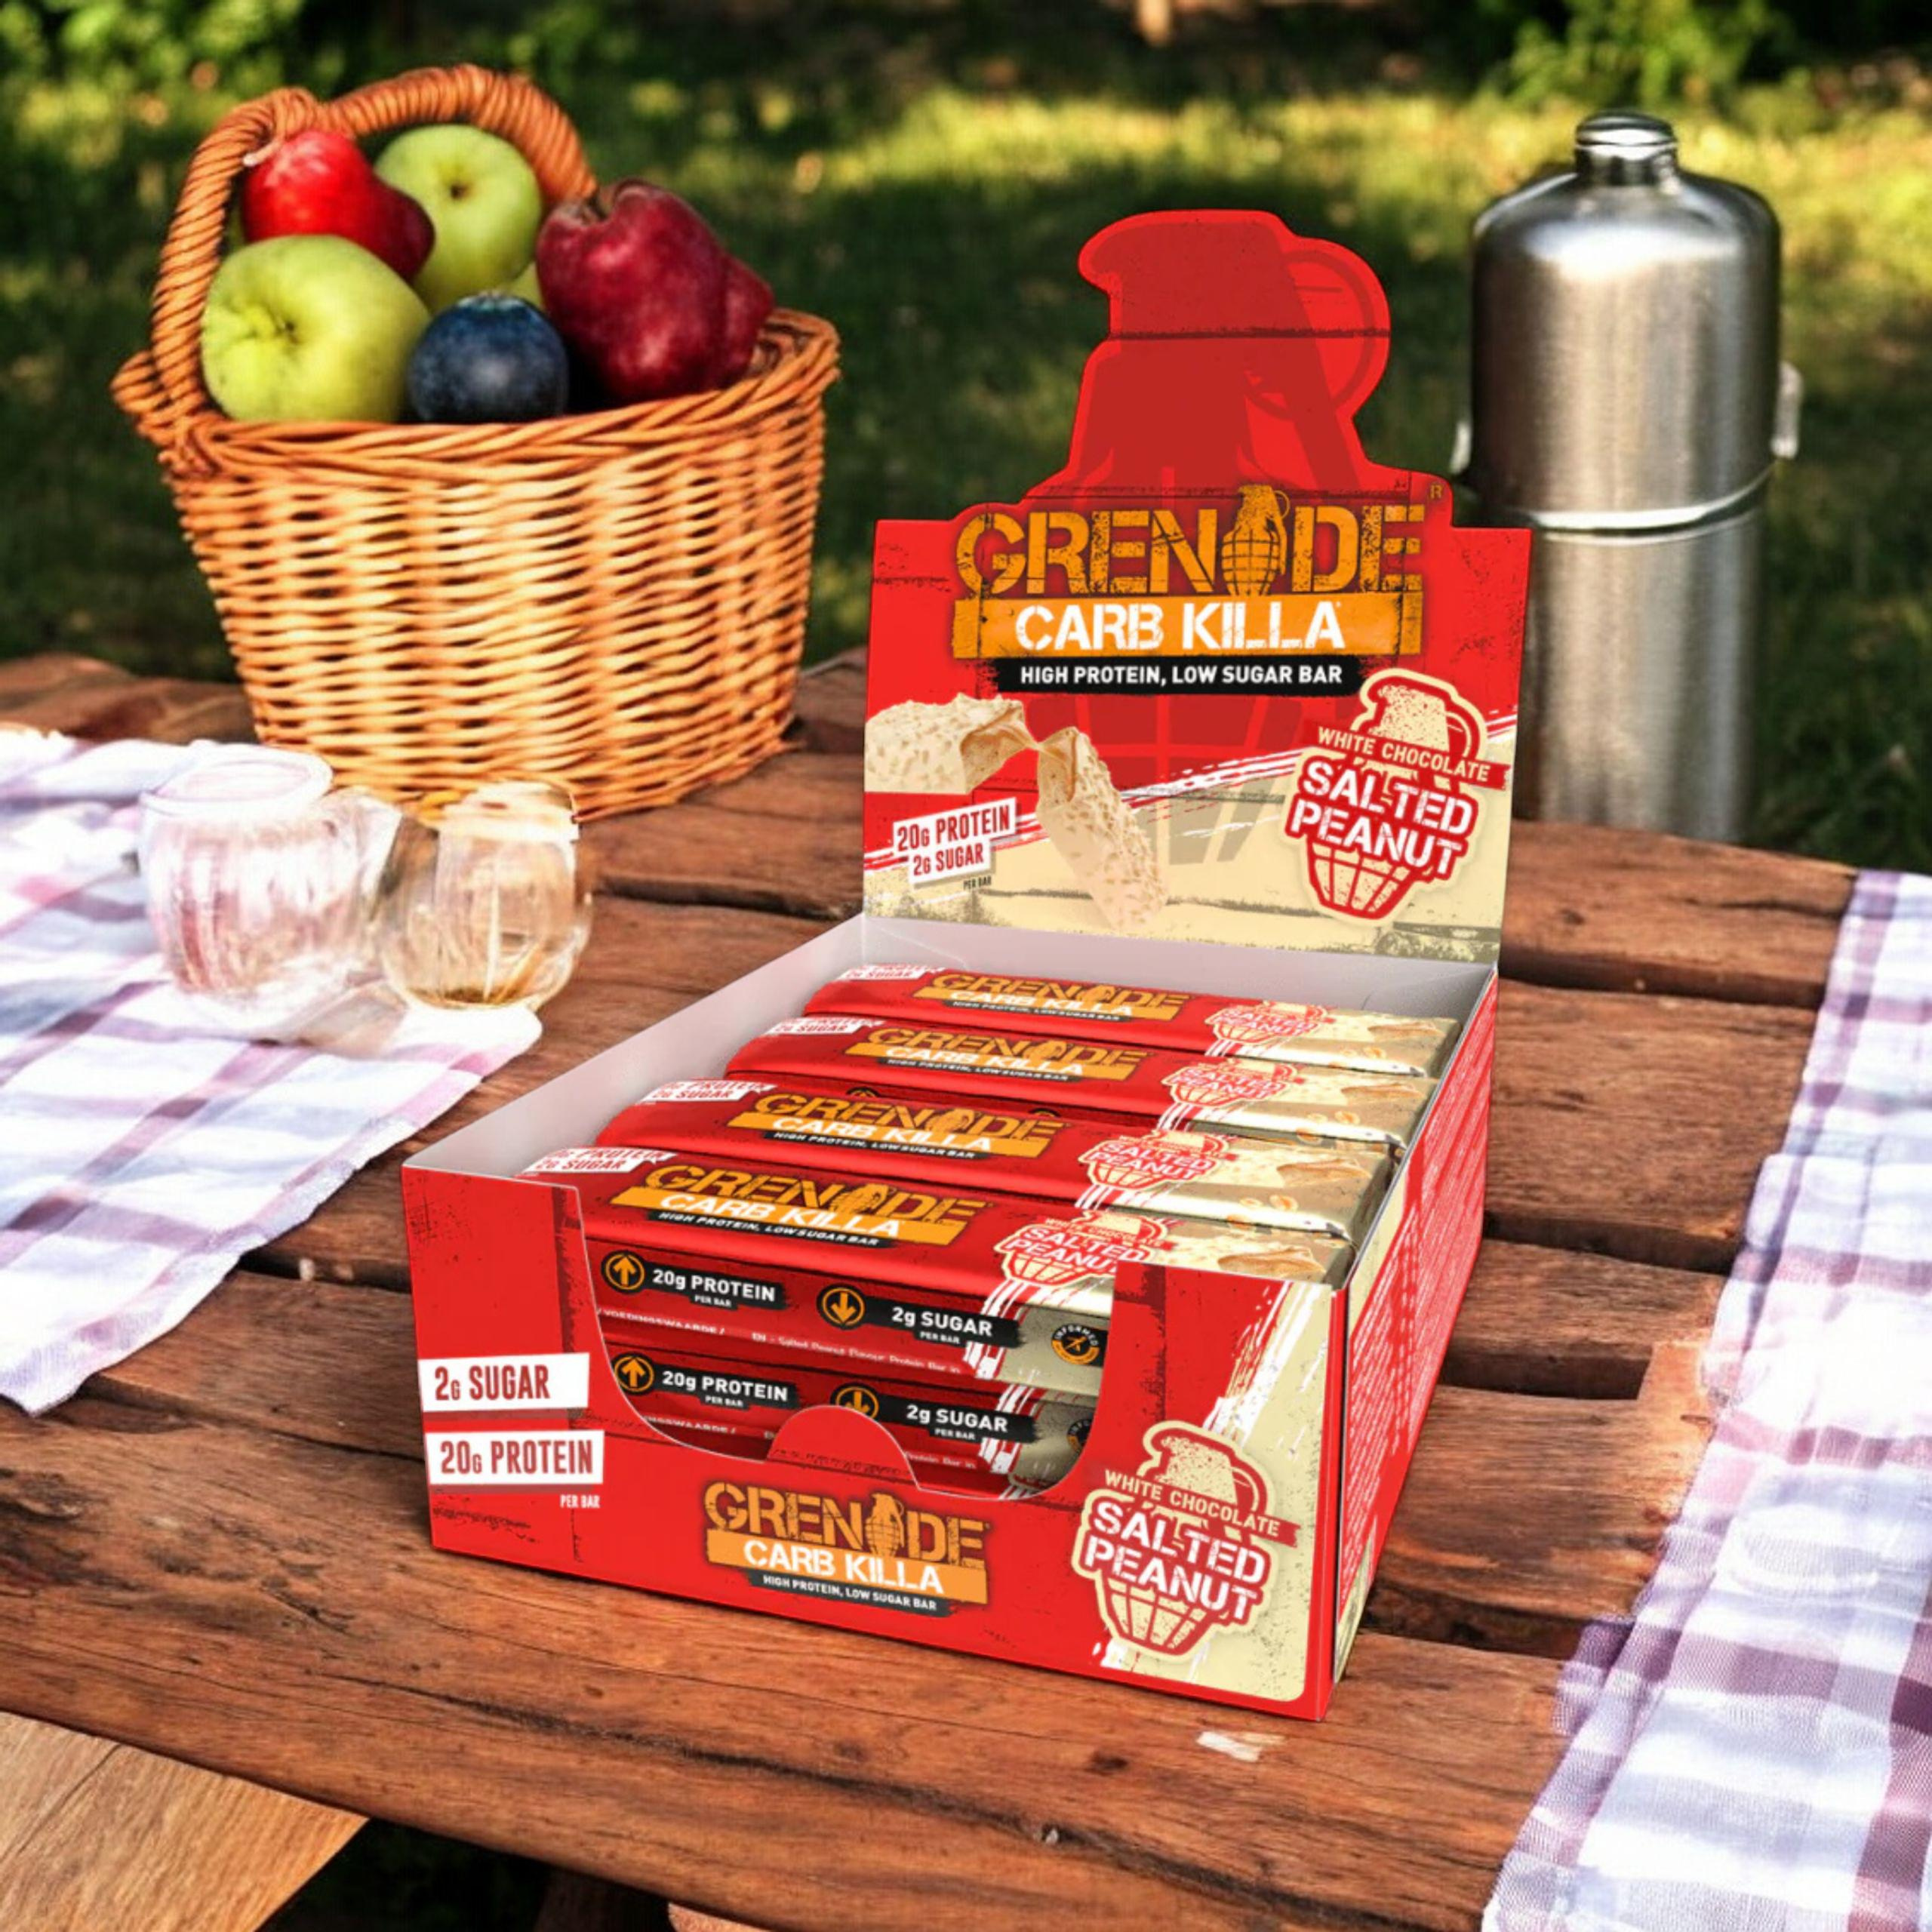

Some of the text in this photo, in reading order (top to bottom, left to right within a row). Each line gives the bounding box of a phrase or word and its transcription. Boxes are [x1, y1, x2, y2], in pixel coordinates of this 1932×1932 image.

[1015, 601, 1344, 651] CARB KILLA
[1020, 665, 1343, 687] HIGH PROTEIN, LOW SUGAR BAR
[1318, 727, 1491, 782] WHITE CHOCOLATE
[1303, 761, 1472, 835] SALTED
[935, 804, 1010, 844] PROTEIN
[1291, 798, 1463, 875] PEANUT
[935, 843, 984, 872] SUGAR
[963, 878, 977, 890] PER
[949, 991, 1132, 1016] CARB KILLA
[1221, 1006, 1318, 1031] SALTED
[885, 1046, 1083, 1075] CARB KILLA
[1171, 1076, 1271, 1100] PEANUT
[1186, 1068, 1283, 1091] SALTED
[772, 1117, 991, 1151] CARB KILLA
[774, 1132, 807, 1141] HIGH
[870, 1142, 900, 1150] LOW
[946, 1149, 976, 1159] BAR
[561, 1159, 626, 1170] SUGAR
[1088, 1151, 1201, 1179] PEANUT
[1103, 1142, 1216, 1170] SALTED
[658, 1211, 696, 1223] HIGH
[764, 1225, 798, 1235] LOW
[798, 1229, 847, 1242] SUGAR
[847, 1236, 880, 1246] BAR
[660, 1193, 900, 1238] CARB KILLA
[1023, 1227, 1146, 1262] SALTED
[652, 1269, 776, 1303] 20g PROTEIN
[694, 1295, 732, 1308] PER BAR
[891, 1306, 993, 1337] 2g SUGAR
[919, 1331, 960, 1345] PER BAR
[468, 1364, 551, 1401] SUGAR
[662, 1371, 788, 1402] 20g PROTEIN
[705, 1395, 743, 1407] PER BAR
[906, 1404, 1009, 1433] 2g SUGAR
[934, 1427, 977, 1441] PER BAR
[491, 1439, 593, 1475] PROTEIN
[559, 1494, 601, 1509] PER BAR
[1105, 1469, 1281, 1538] WHITE CHOCOLATE
[1094, 1501, 1266, 1584] SALTED
[743, 1539, 944, 1595] CARB KILLA
[1084, 1535, 1258, 1620] PEANUT
[763, 1574, 937, 1611] HIGH PROTEIN, LOW SUGAR BAR
